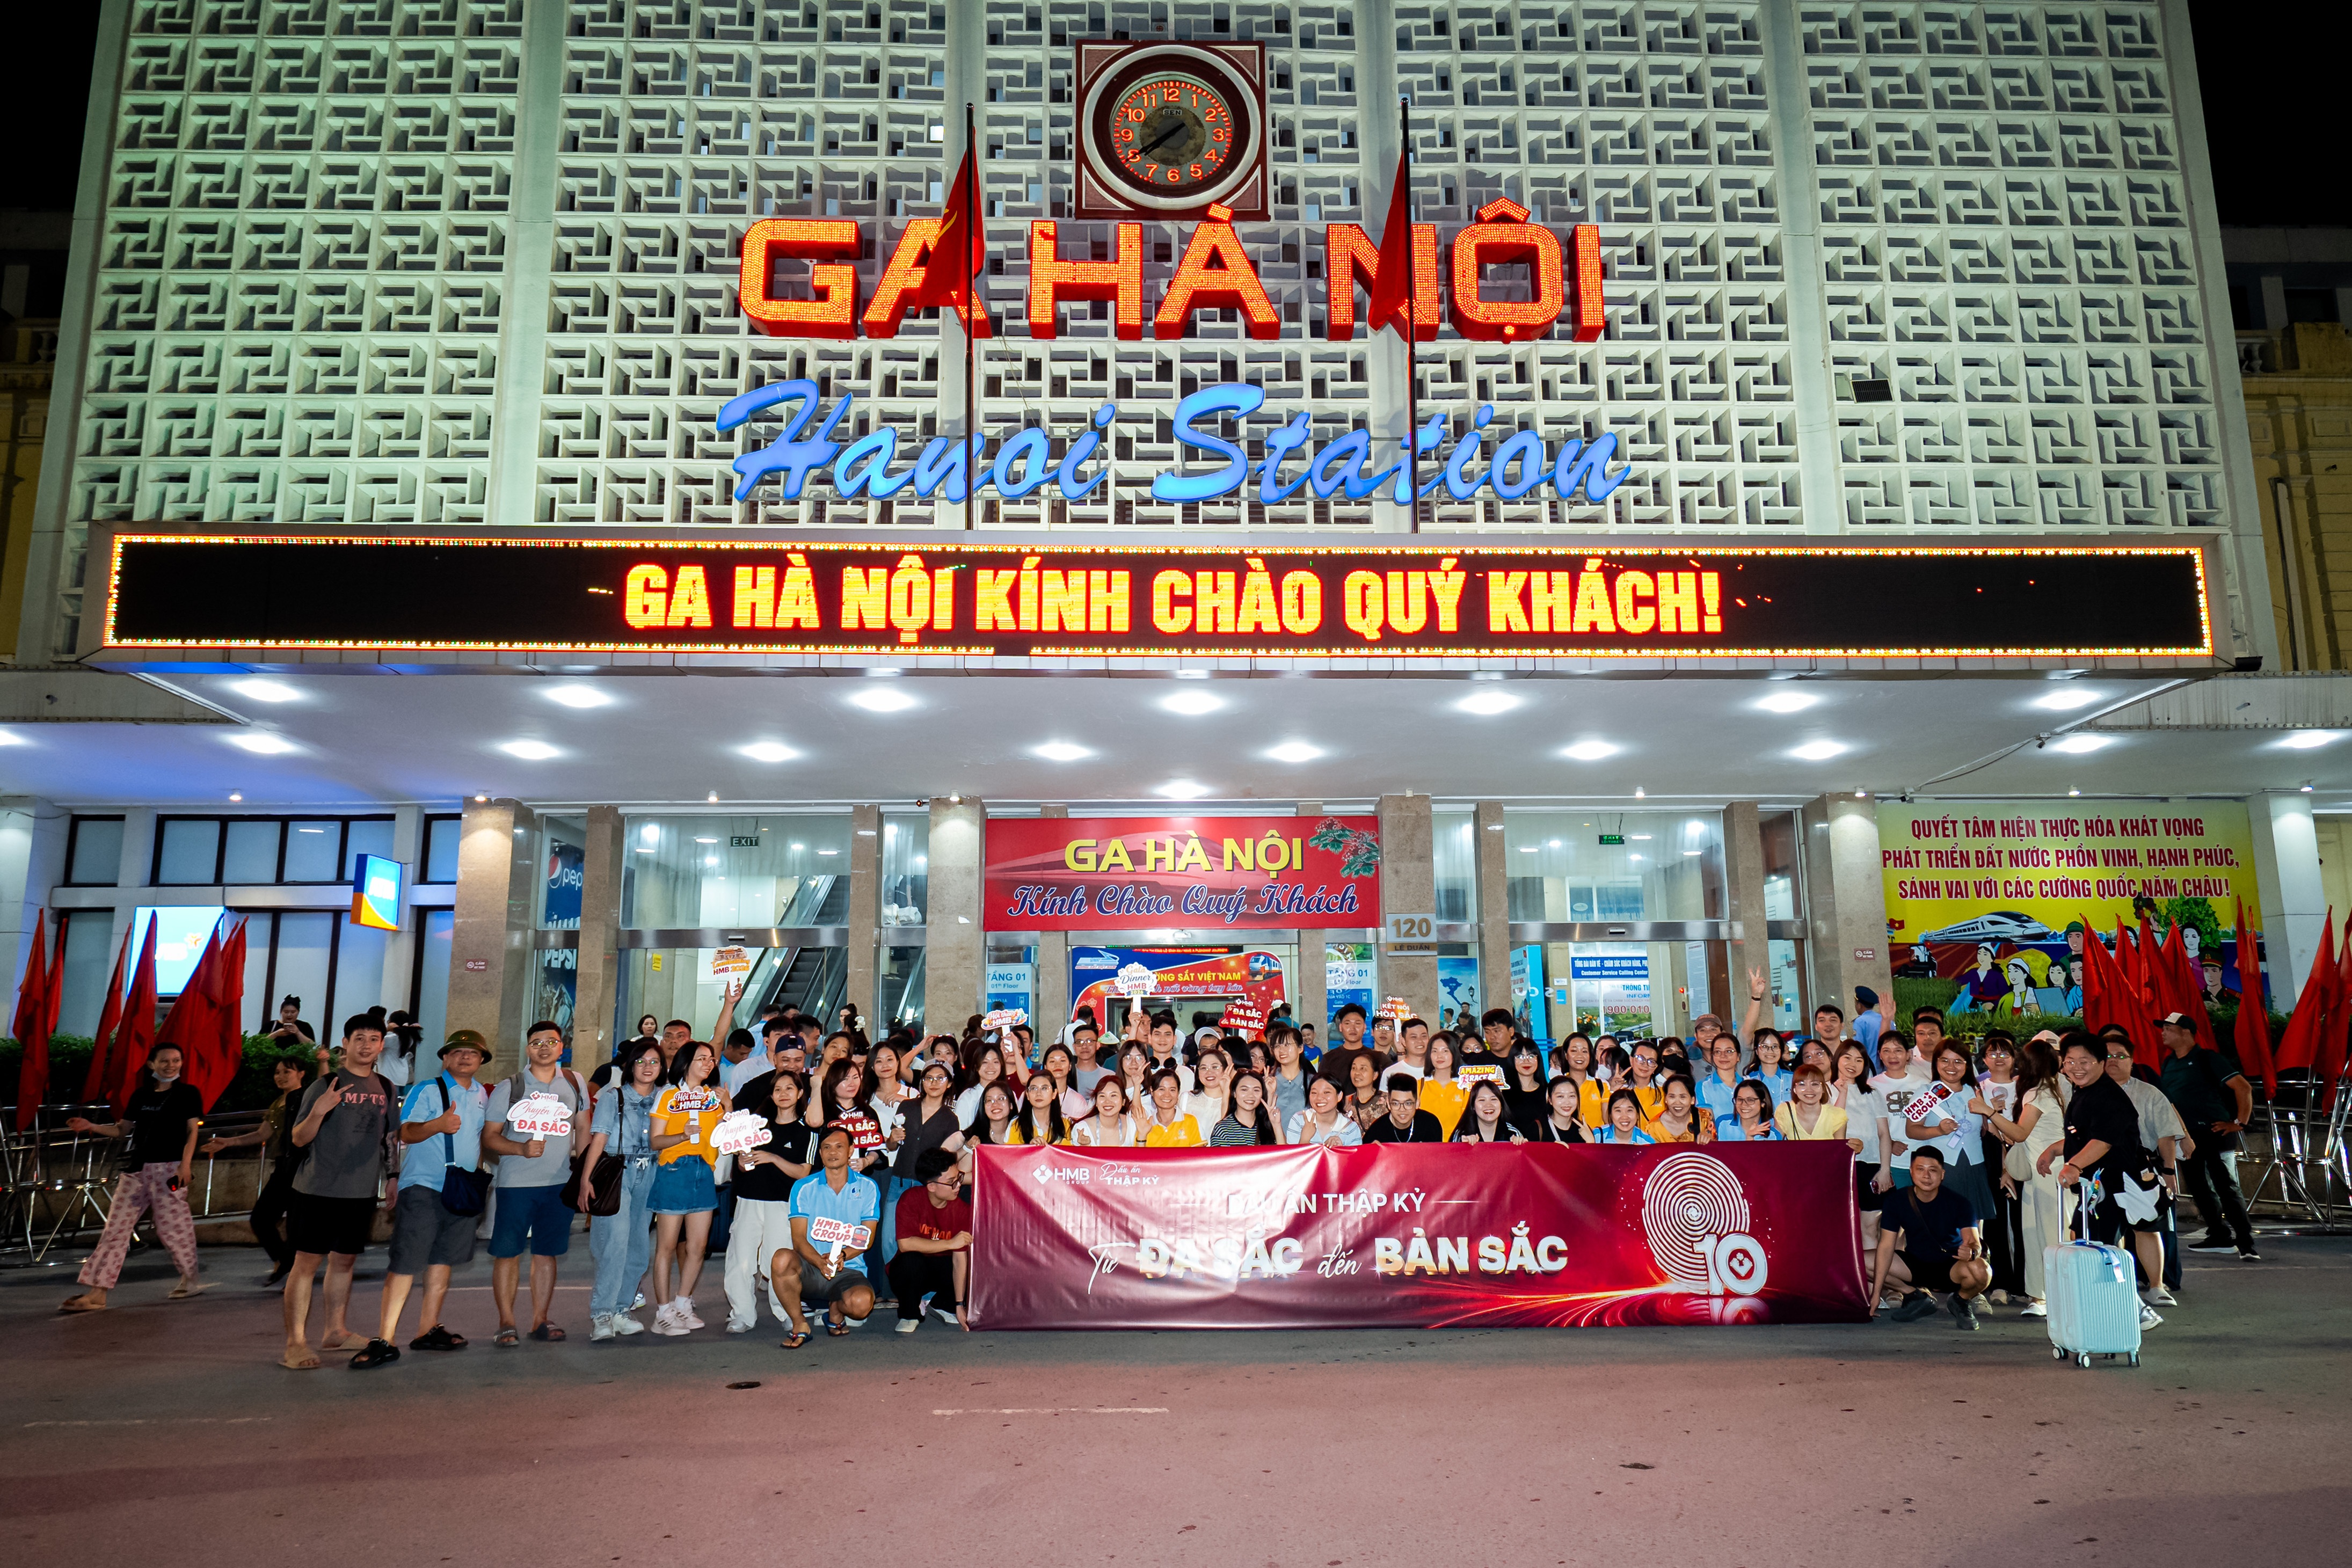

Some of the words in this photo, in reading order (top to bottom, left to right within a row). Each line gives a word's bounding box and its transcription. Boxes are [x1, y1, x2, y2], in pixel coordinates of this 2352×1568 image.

[1143, 94, 1157, 107] 11
[1163, 88, 1181, 102] 12
[1192, 94, 1198, 107] 1
[1127, 108, 1146, 122] 10
[1205, 108, 1218, 122] 2
[1120, 129, 1134, 142] 9
[1212, 129, 1226, 142] 3
[1127, 149, 1142, 162] 8
[1204, 149, 1218, 162] 4
[1146, 164, 1159, 178] 7
[1167, 169, 1181, 183] 6
[1190, 164, 1203, 178] 5
[739, 218, 992, 340] GA
[1029, 204, 1281, 341] HÀ
[1327, 197, 1605, 342] NỘI
[715, 377, 1116, 504] Hanoi
[1151, 383, 1632, 505] Station
[625, 564, 713, 628] GA
[733, 554, 820, 629] HÀ
[841, 555, 955, 643] NỘI
[975, 556, 1131, 632] KÍNH
[1151, 557, 1322, 635] CHÀO
[1344, 557, 1466, 640] QUÝ
[1487, 557, 1722, 635] KHÁCH!
[1911, 814, 1958, 840] QUYẾT
[1962, 816, 1996, 837] TÂM
[2000, 816, 2037, 842] HIỆN
[2041, 817, 2080, 841] THỰC
[2084, 815, 2116, 837] HÓA
[2120, 815, 2158, 837] KHÁT
[2162, 818, 2204, 841] VỌNG
[733, 837, 757, 845] EXIT
[1065, 839, 1134, 872] GA
[1146, 830, 1213, 871] HÀ
[1223, 830, 1302, 879] NỘI
[1882, 846, 1921, 868] PHÁT
[1925, 842, 1971, 868] TRIỂN
[1975, 843, 2003, 868] ĐẤT
[2008, 846, 2050, 867] NƯỚC
[2055, 843, 2098, 867] PHỒN
[2101, 849, 2143, 869] VINH,
[2146, 848, 2188, 871] HẠNH
[2193, 844, 2239, 869] PHÚC,
[563, 867, 583, 891] pep
[1898, 877, 1940, 899] SÁNH
[1945, 880, 1969, 899] VAI
[1973, 876, 1999, 898] VỚI
[2004, 876, 2034, 898] CÁC
[2039, 876, 2092, 898] CƯỜNG
[2096, 873, 2137, 900] QUỐC
[2142, 875, 2178, 897] NĂM
[2182, 874, 2230, 898] CHÂU!
[1009, 885, 1087, 916] Kính
[1095, 885, 1174, 915] Chào
[1182, 884, 1247, 924] Quý
[1254, 883, 1359, 914] Khách
[1392, 917, 1431, 938] 120
[1407, 943, 1430, 951] DUẨN
[544, 949, 577, 969] PEPSI
[713, 967, 729, 975] HMB
[1126, 966, 1146, 976] Gala
[1178, 969, 1195, 981] SẮT
[1198, 971, 1216, 983] VIỆT
[1219, 973, 1241, 981] NAM
[1121, 974, 1151, 984] Dinner
[1622, 983, 1641, 991] THÔNG
[988, 1010, 1000, 1019] Hội
[1233, 1008, 1244, 1016] ĐA
[1246, 1008, 1262, 1018] SẮC
[1375, 1009, 1396, 1018] HÒA
[1398, 1010, 1417, 1019] SẮC
[1603, 1005, 1627, 1014] 1900
[1629, 1005, 1649, 1014] 010
[992, 1018, 1012, 1026] HMB
[1230, 1017, 1247, 1027] BẢN
[1248, 1019, 1264, 1029] SẮC
[675, 1091, 689, 1101] Hội
[511, 1102, 550, 1119] Chuyến
[554, 1106, 569, 1117] tàu
[679, 1101, 702, 1110] HMB
[1904, 1098, 1924, 1116] HMB
[1911, 1097, 1938, 1121] GROUP
[733, 1110, 748, 1118] HMB
[517, 1119, 537, 1131] ĐA
[540, 1118, 569, 1133] SẮC
[713, 1121, 747, 1144] Chuyến
[751, 1116, 765, 1129] tàu
[855, 1119, 876, 1131] SẮC
[723, 1139, 742, 1151] ĐA
[745, 1129, 770, 1146] SẮC
[860, 1132, 880, 1144] SẮC
[1054, 1168, 1089, 1180] HMB
[1099, 1162, 1128, 1180] Dấu
[1131, 1165, 1141, 1173] ấn
[1106, 1175, 1139, 1187] THẬP
[1142, 1175, 1160, 1185] KỶ
[1291, 1189, 1317, 1214] ẤN
[1323, 1188, 1387, 1217] THẬP
[1394, 1187, 1426, 1213] KỶ
[815, 1219, 841, 1231] HMB
[813, 1229, 851, 1242] GROUP
[1088, 1242, 1136, 1294] Từ
[1136, 1238, 1202, 1279] ĐA
[1212, 1223, 1305, 1279] SẮC
[1317, 1243, 1363, 1279] đến
[1374, 1227, 1470, 1276] BẢN
[1478, 1220, 1568, 1275] SẮC
[1693, 1232, 1768, 1296] 10
